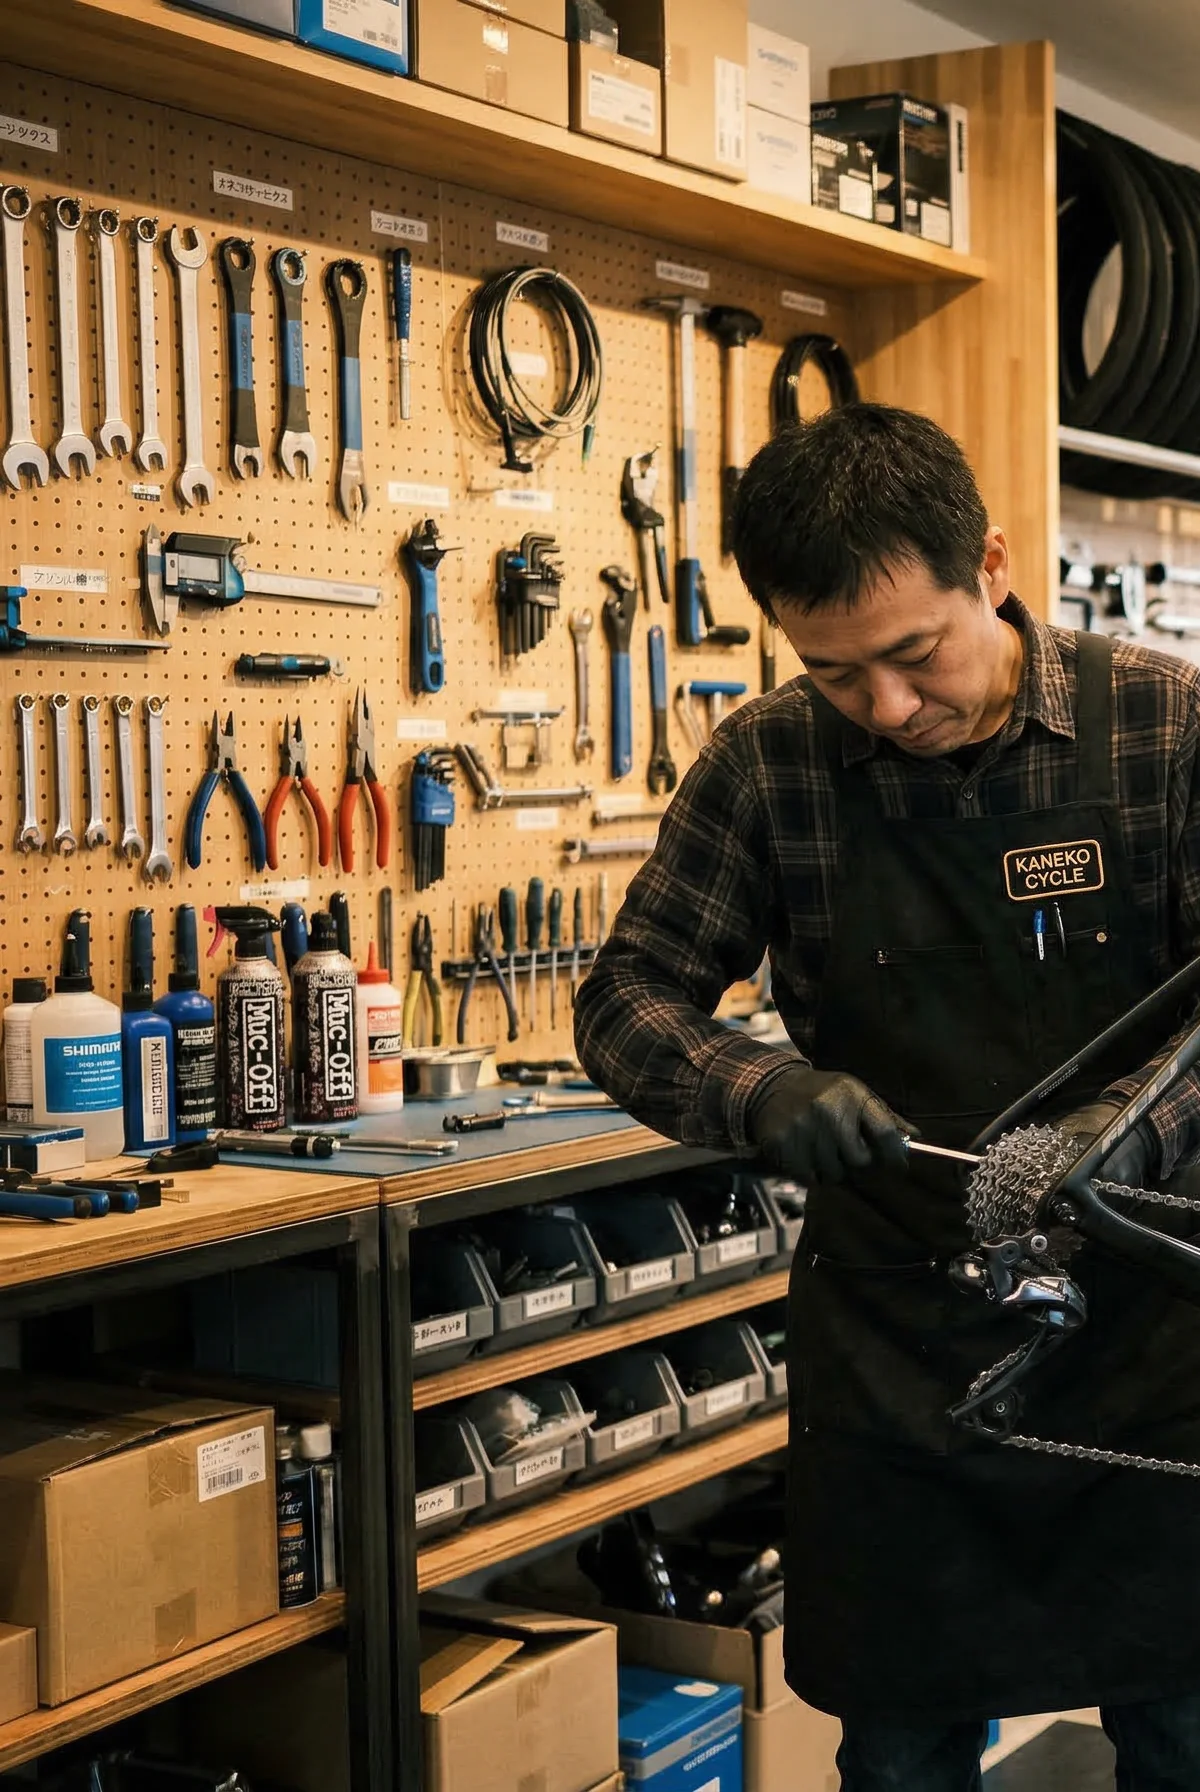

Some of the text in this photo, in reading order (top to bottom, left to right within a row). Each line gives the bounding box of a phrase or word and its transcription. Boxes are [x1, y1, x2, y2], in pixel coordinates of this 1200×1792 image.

[1015, 848, 1091, 874] KANEKO
[1025, 867, 1086, 890] CYCLE
[247, 1002, 274, 1110] Muc-Off
[328, 994, 353, 1096] Muc-Off
